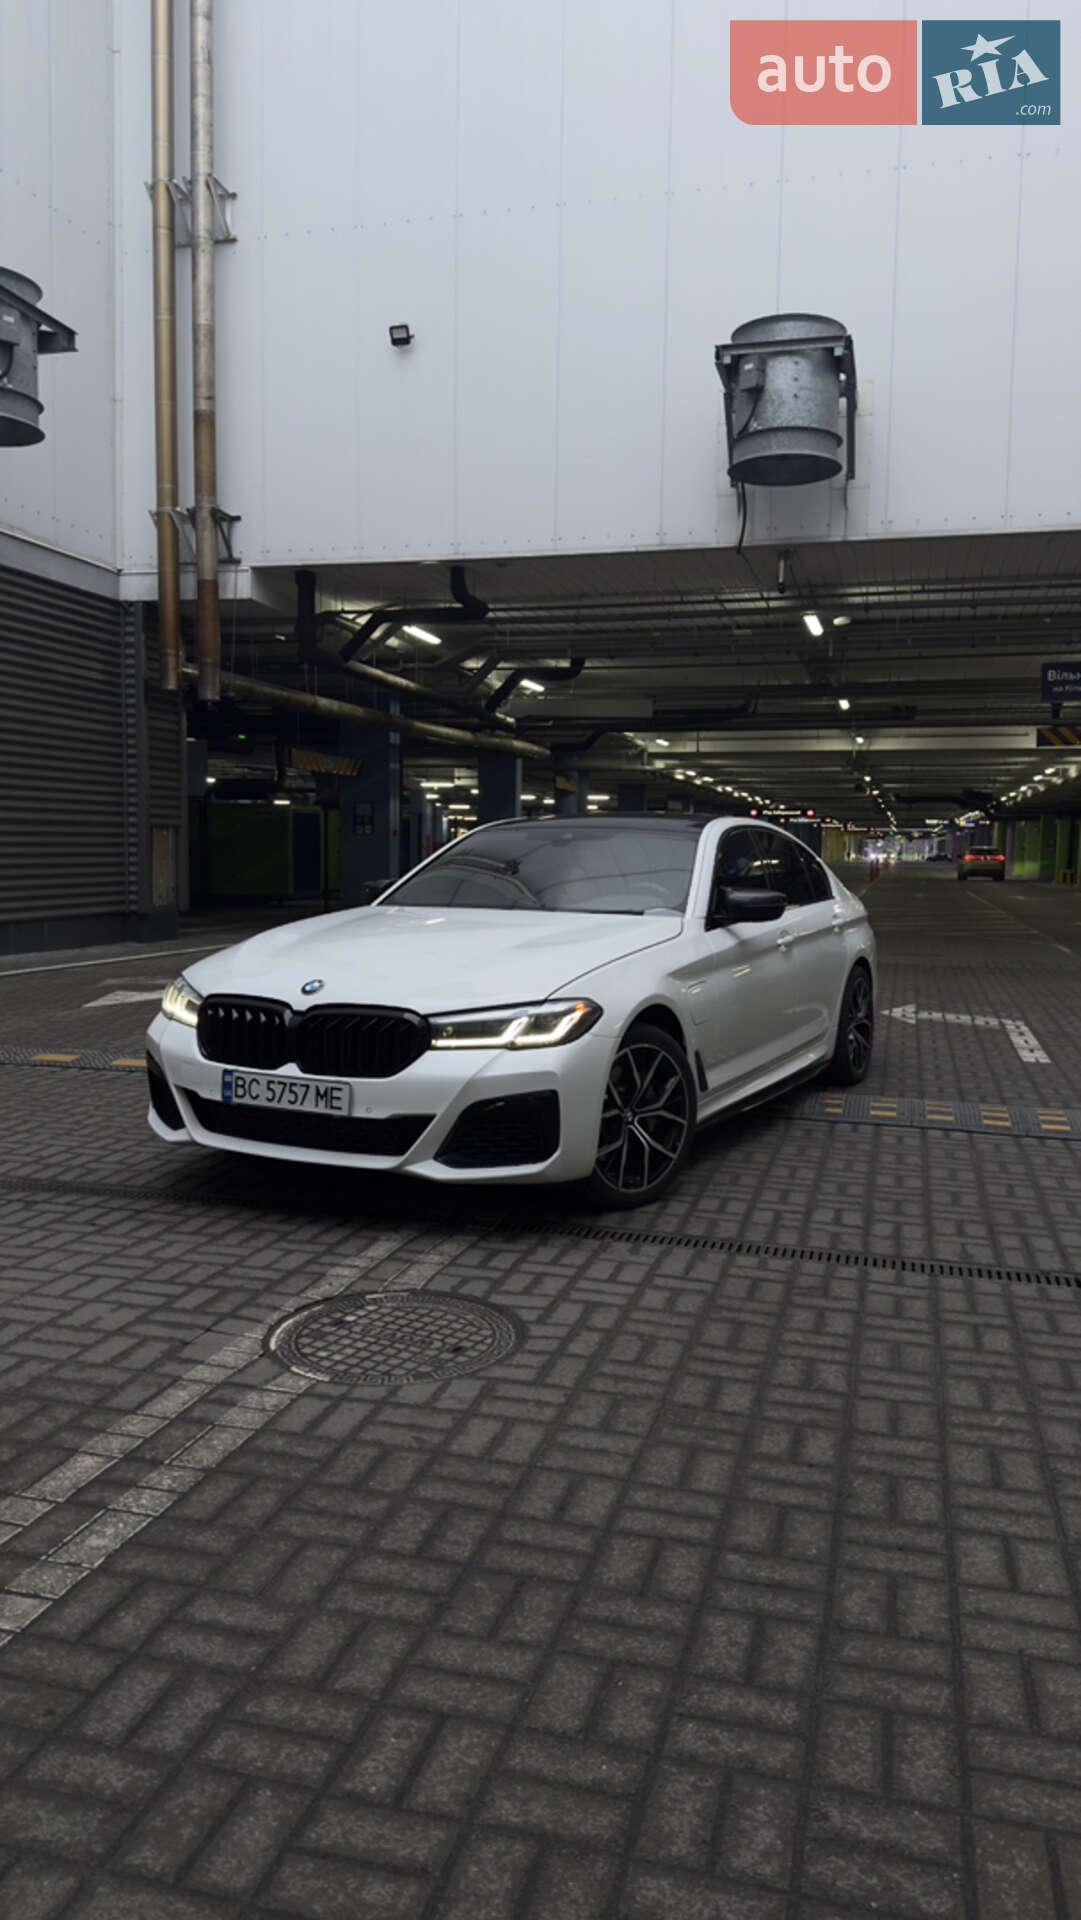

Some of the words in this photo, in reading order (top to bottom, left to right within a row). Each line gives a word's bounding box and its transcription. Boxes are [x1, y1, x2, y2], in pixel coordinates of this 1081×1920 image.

[234, 1076, 260, 1100] BC
[265, 1080, 310, 1106] 5757
[315, 1085, 343, 1111] ME
